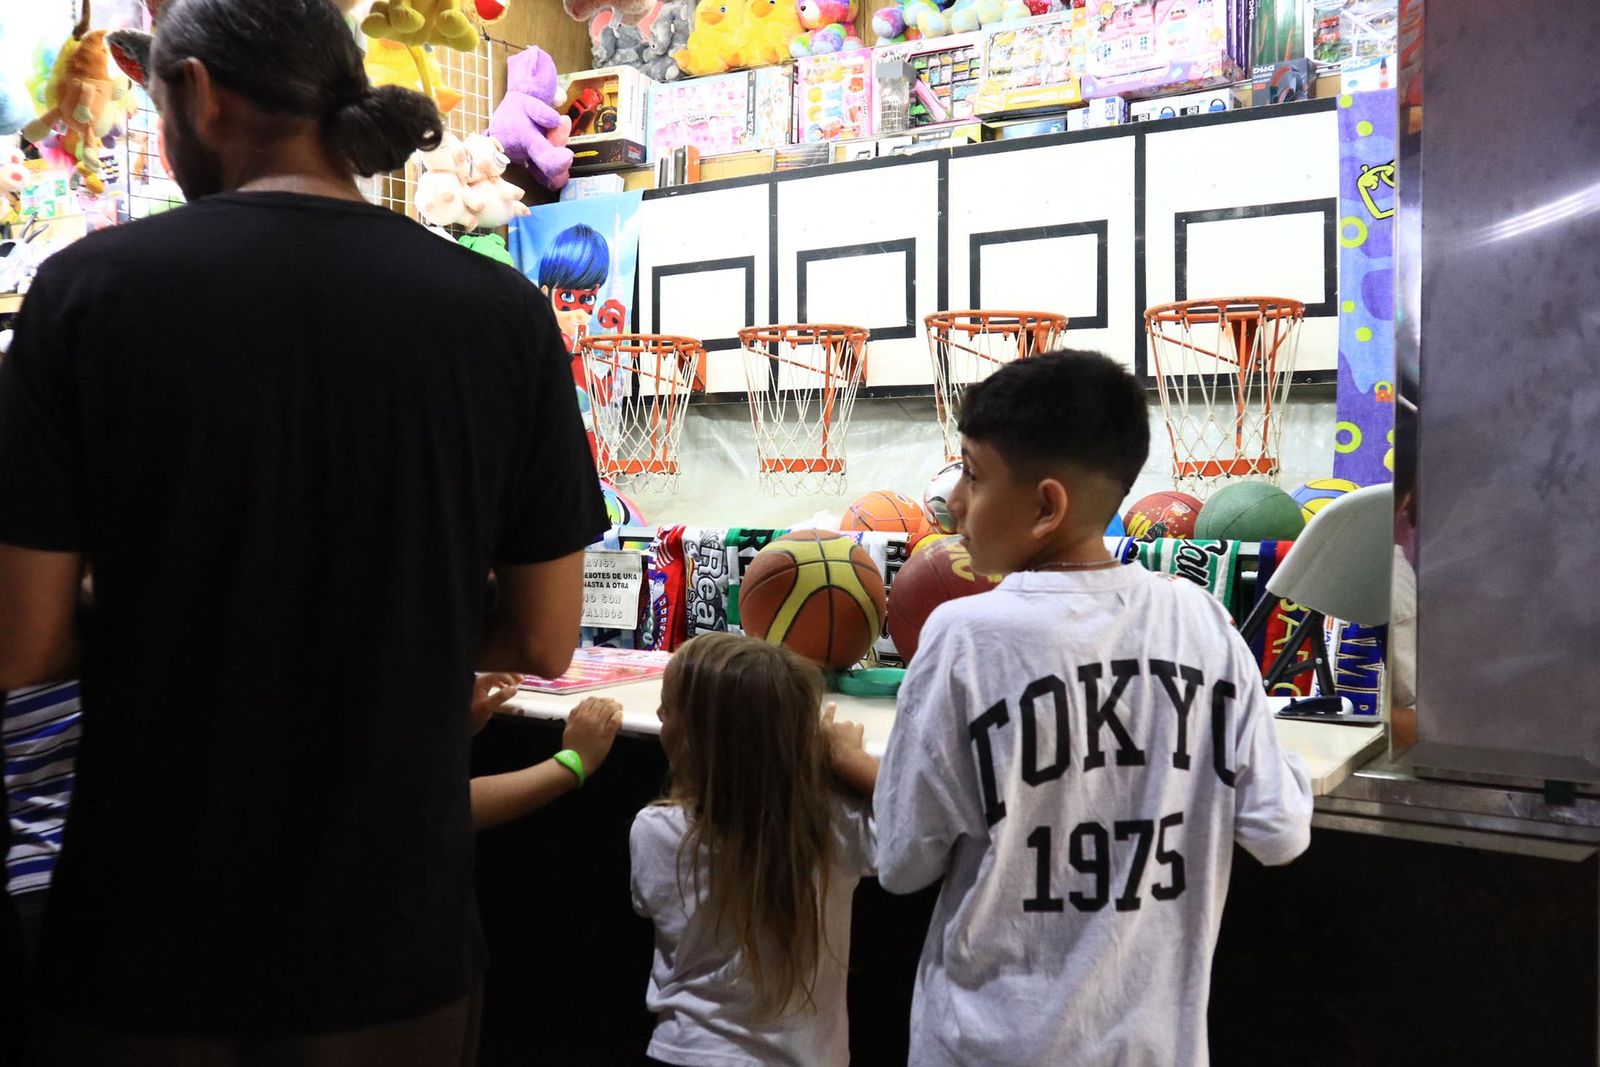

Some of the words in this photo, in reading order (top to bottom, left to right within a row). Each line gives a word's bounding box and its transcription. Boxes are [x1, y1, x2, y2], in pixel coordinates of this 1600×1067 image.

[586, 558, 616, 568] AVISO
[602, 595, 621, 604] SON
[1023, 811, 1186, 913] 1975
